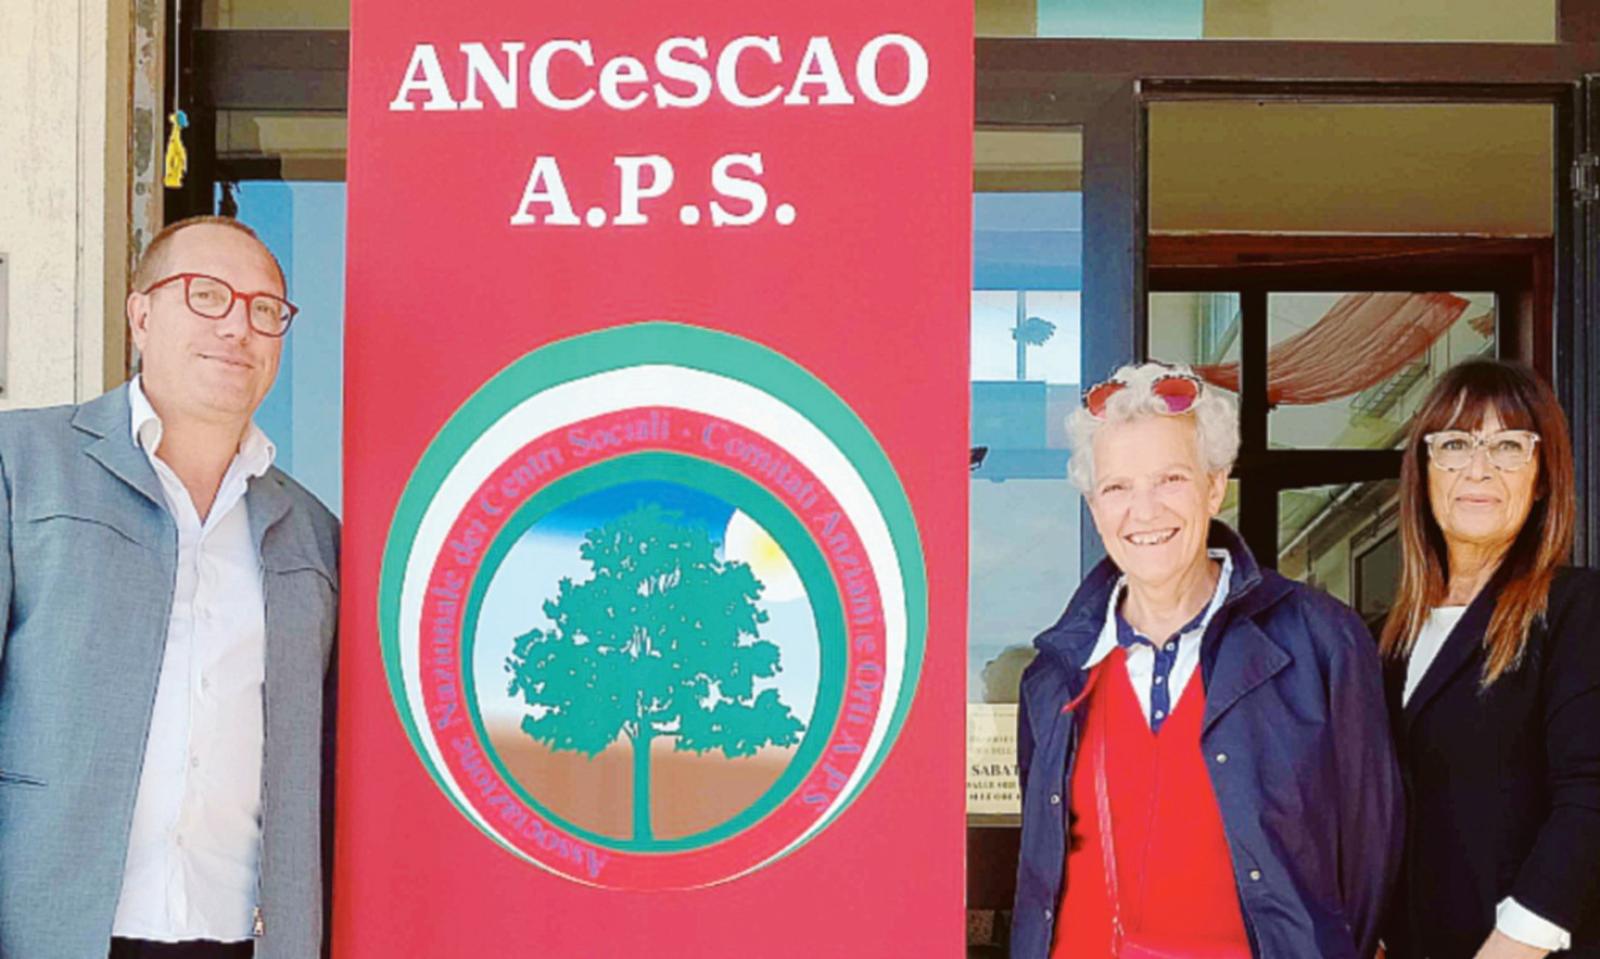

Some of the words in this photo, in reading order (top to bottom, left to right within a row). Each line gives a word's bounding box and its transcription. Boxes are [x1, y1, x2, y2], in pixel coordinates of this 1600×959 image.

[389, 34, 929, 112] ANCeSCAO
[510, 152, 797, 228] A.P.S.
[567, 410, 670, 457] Sociali
[703, 420, 817, 510] Comitati
[480, 447, 565, 515] Centri
[431, 570, 466, 730] Nazionale
[451, 736, 610, 878] Associazione
